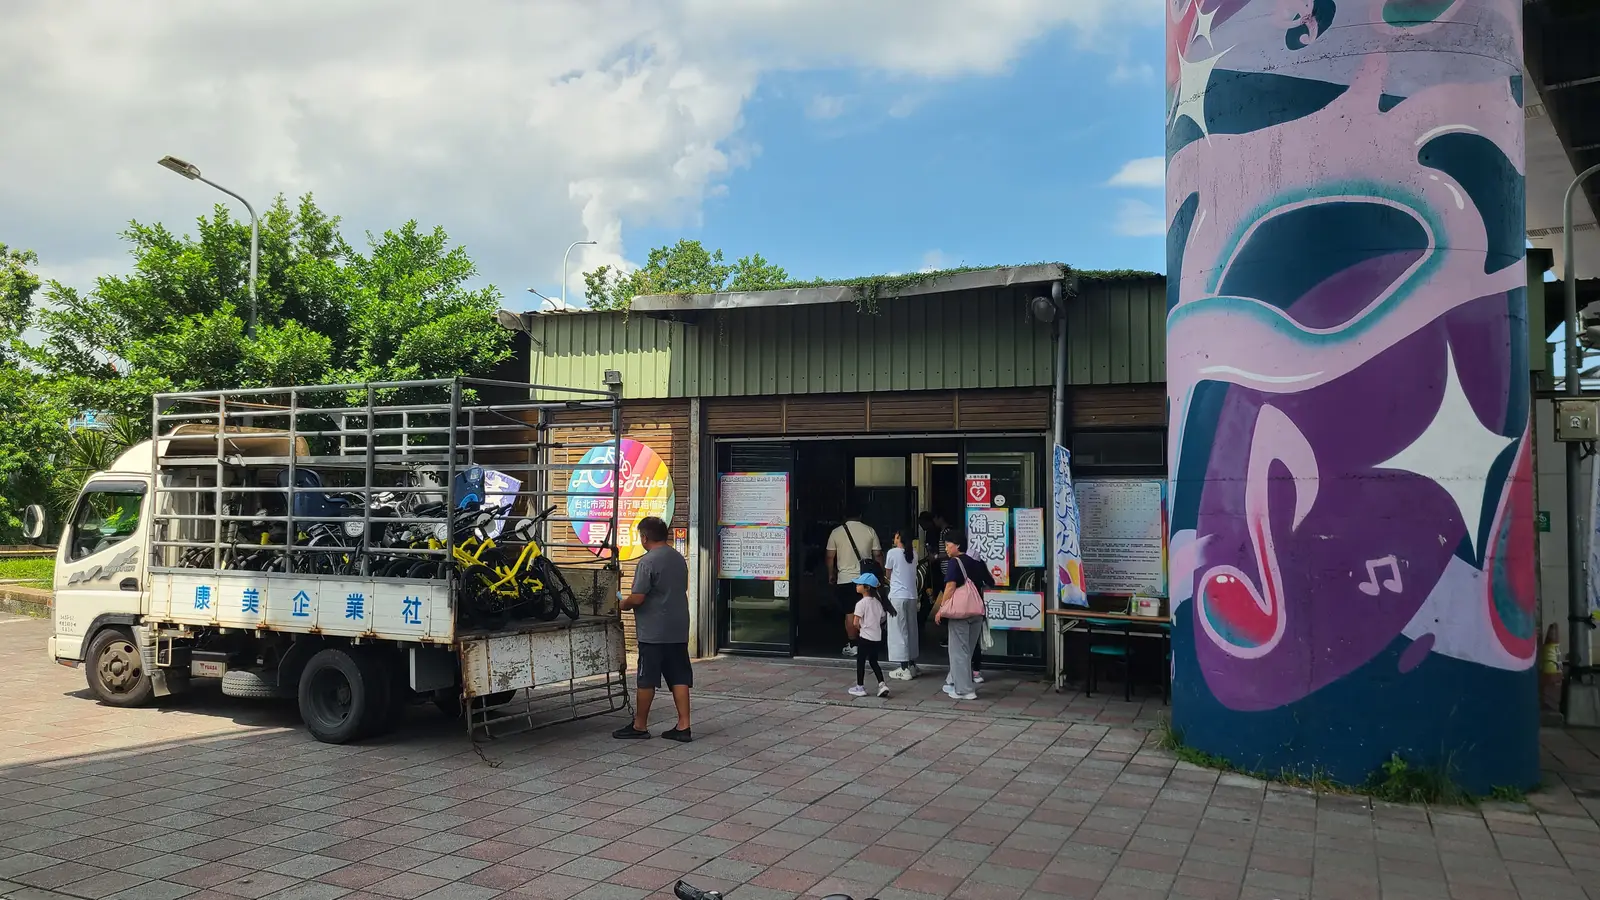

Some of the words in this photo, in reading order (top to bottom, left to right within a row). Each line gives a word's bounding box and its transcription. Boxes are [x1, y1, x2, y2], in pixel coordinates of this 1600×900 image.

[624, 473, 669, 494] Taipei
[987, 520, 1005, 560] 車友
[194, 586, 421, 624] 康美企業社
[984, 599, 1021, 621] 氣區
